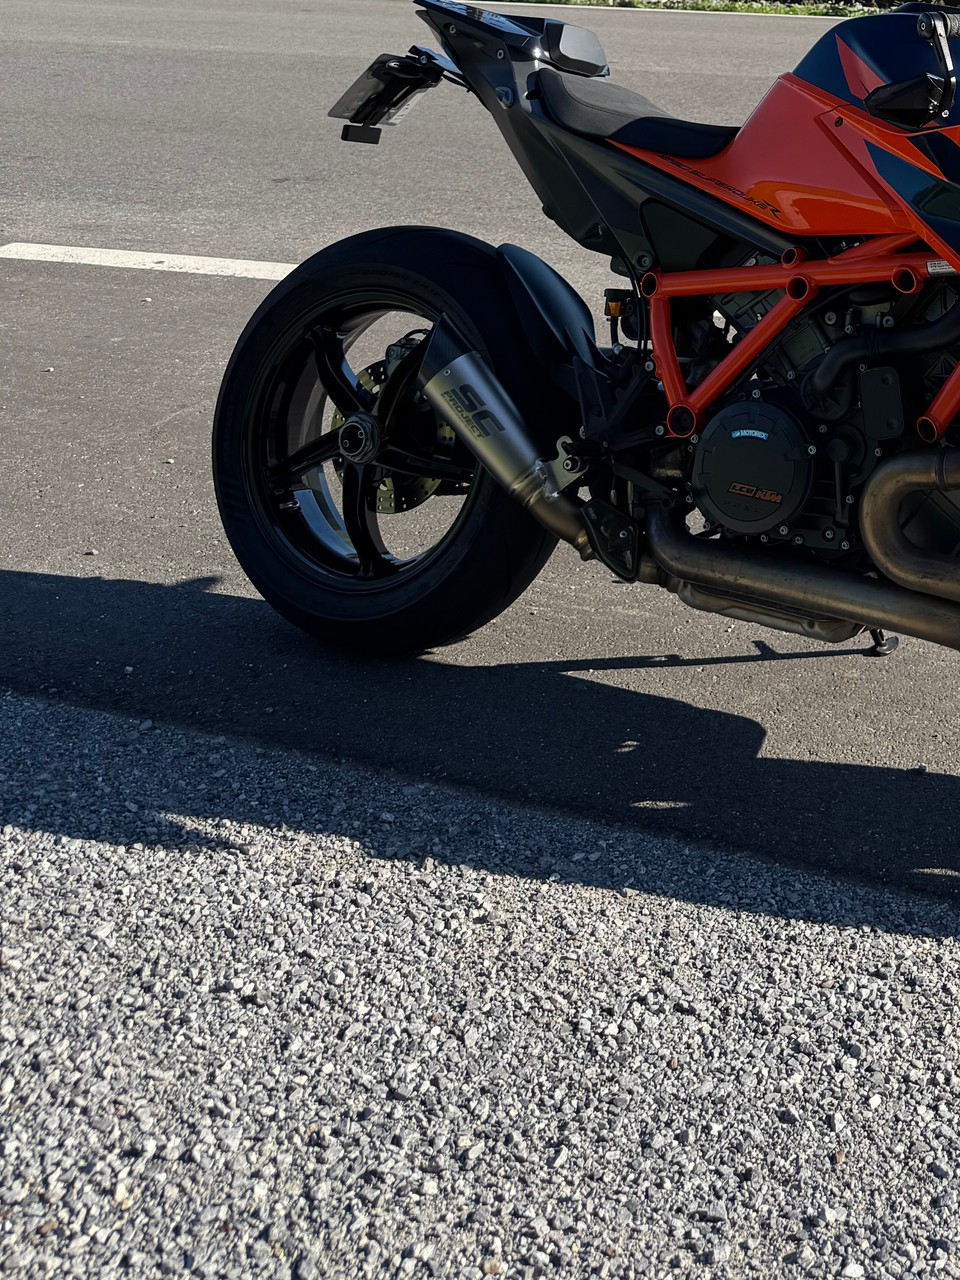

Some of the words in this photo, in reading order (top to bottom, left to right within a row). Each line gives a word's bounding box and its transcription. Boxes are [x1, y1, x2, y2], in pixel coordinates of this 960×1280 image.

[443, 390, 486, 439] PROJECT
[450, 384, 506, 437] SC
[740, 429, 768, 440] MOTOREX
[755, 489, 782, 503] KTM
